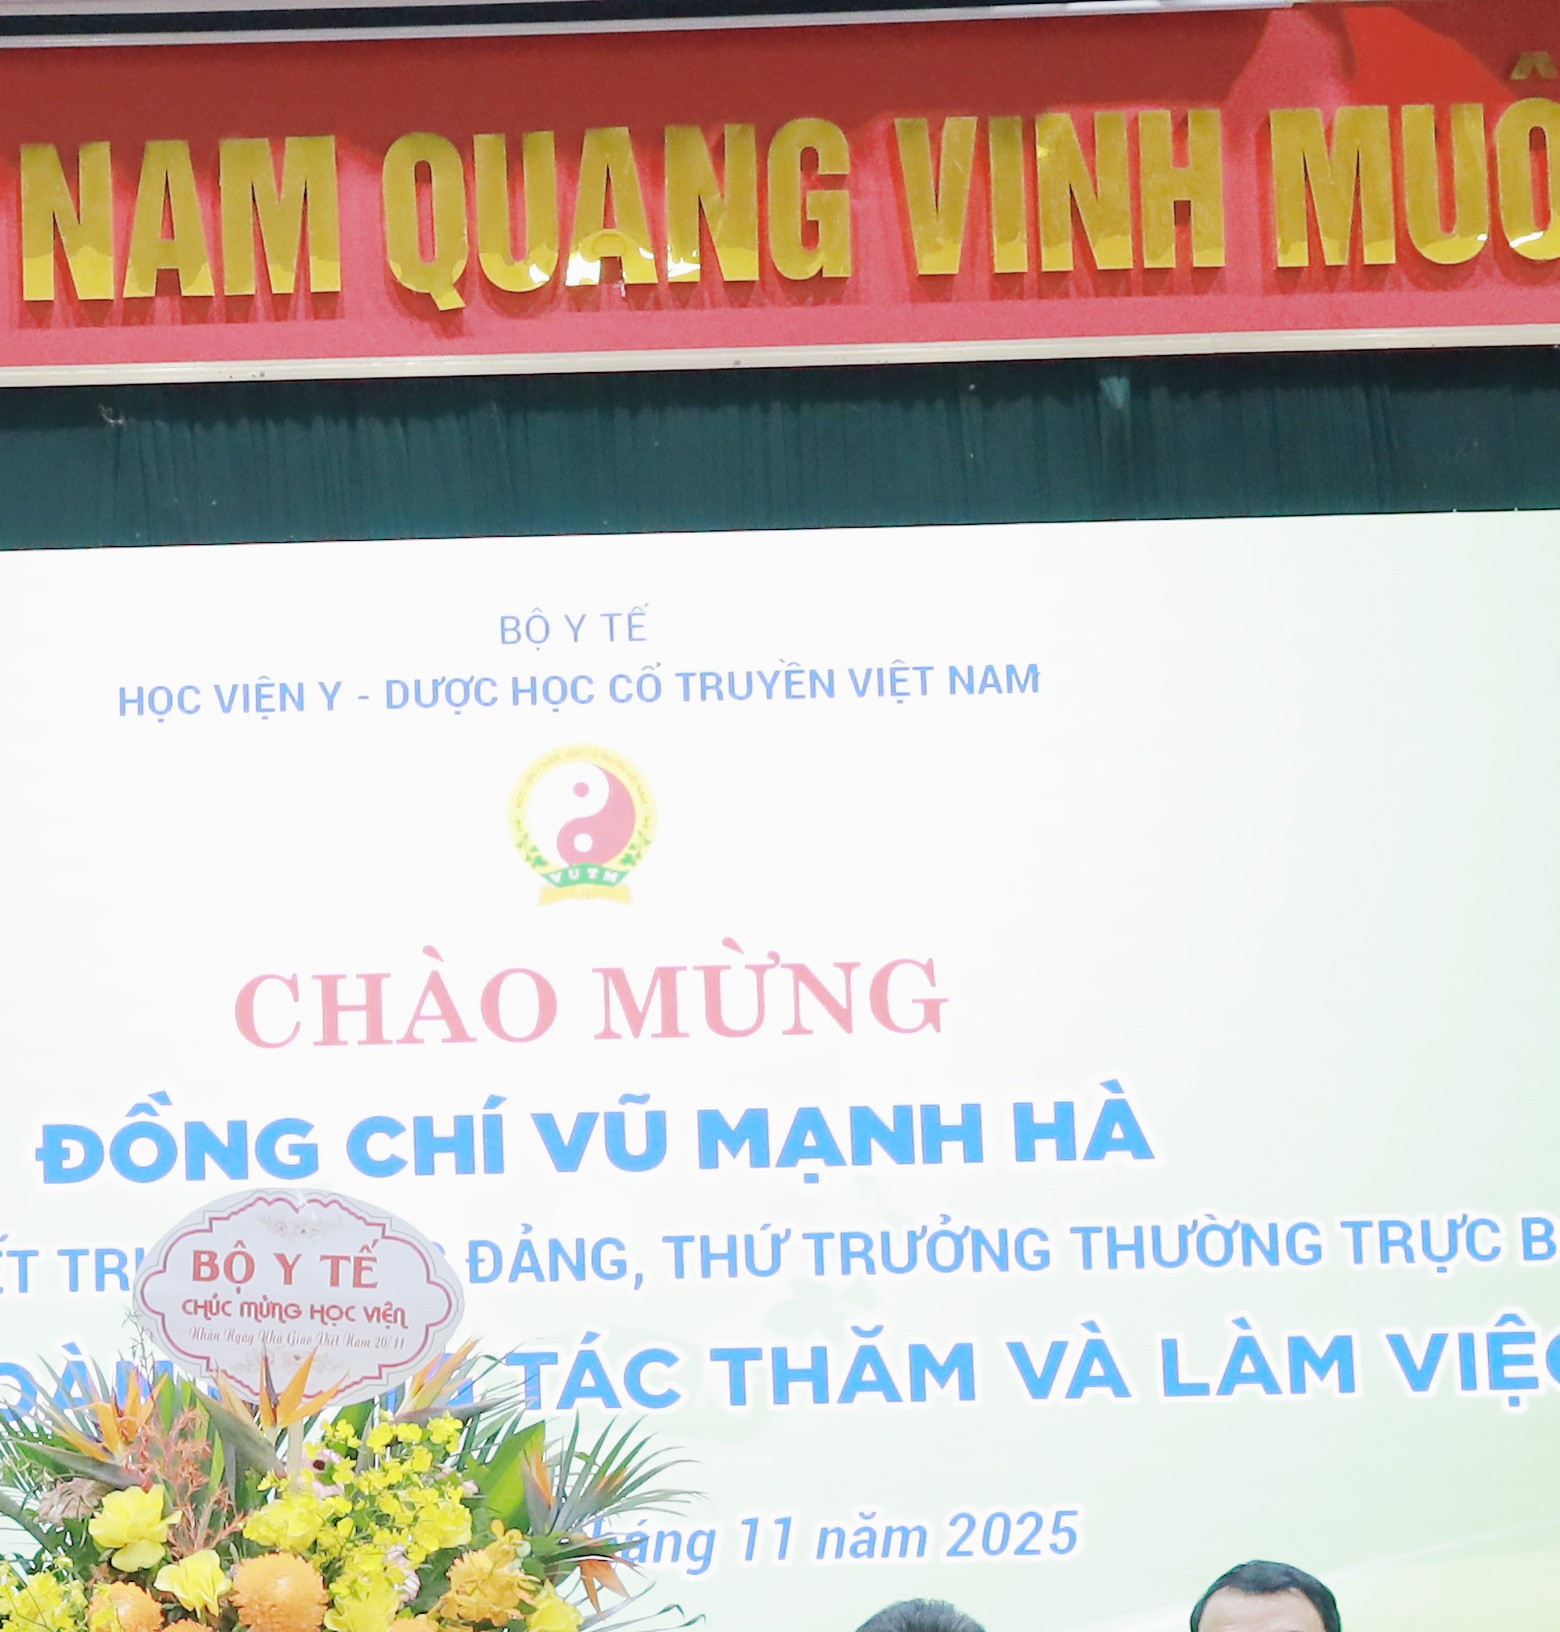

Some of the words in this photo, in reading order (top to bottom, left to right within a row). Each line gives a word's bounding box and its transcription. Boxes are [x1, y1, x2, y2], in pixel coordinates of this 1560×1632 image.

[17, 132, 340, 305] NAM
[381, 118, 848, 312] QUANG
[893, 106, 1222, 278] VINH
[498, 606, 551, 654] BỘ
[564, 614, 587, 644] Y
[599, 602, 650, 643] TẾ
[118, 683, 203, 722] HỌC
[215, 675, 305, 720] VIỆN
[316, 680, 343, 712] Y
[383, 674, 499, 715] DƯỢC
[510, 674, 597, 711] HỌC
[607, 663, 664, 703] CỔ
[675, 656, 836, 702] TRUYỀN
[848, 658, 938, 702] VIỆT
[948, 662, 1041, 695] NAM
[549, 865, 619, 885] VUTM
[233, 944, 558, 1049] CHÀO
[592, 936, 949, 1040] MỪNG
[35, 1091, 319, 1184] ĐỒNG
[345, 1094, 507, 1178] CHÍ
[531, 1093, 668, 1173] VŨ
[696, 1103, 984, 1184] MẠNH
[1013, 1078, 1155, 1163] HÀ
[192, 1240, 256, 1294] BỘ
[273, 1252, 303, 1285] Y
[320, 1239, 379, 1289] TẾ
[466, 1224, 644, 1290] ĐẢNG,
[663, 1228, 791, 1282] THỨ
[803, 1214, 1051, 1276] TRƯỞNG
[1070, 1213, 1322, 1271] THƯỜNG
[1341, 1216, 1501, 1273] TRỰC
[506, 1330, 681, 1410] TÁC
[710, 1326, 975, 1406] THĂM
[1006, 1321, 1132, 1400] VÀ
[1161, 1317, 1356, 1397] LÀM
[742, 1517, 792, 1561] 11
[817, 1511, 929, 1560] năm
[947, 1510, 1078, 1558] 2025
